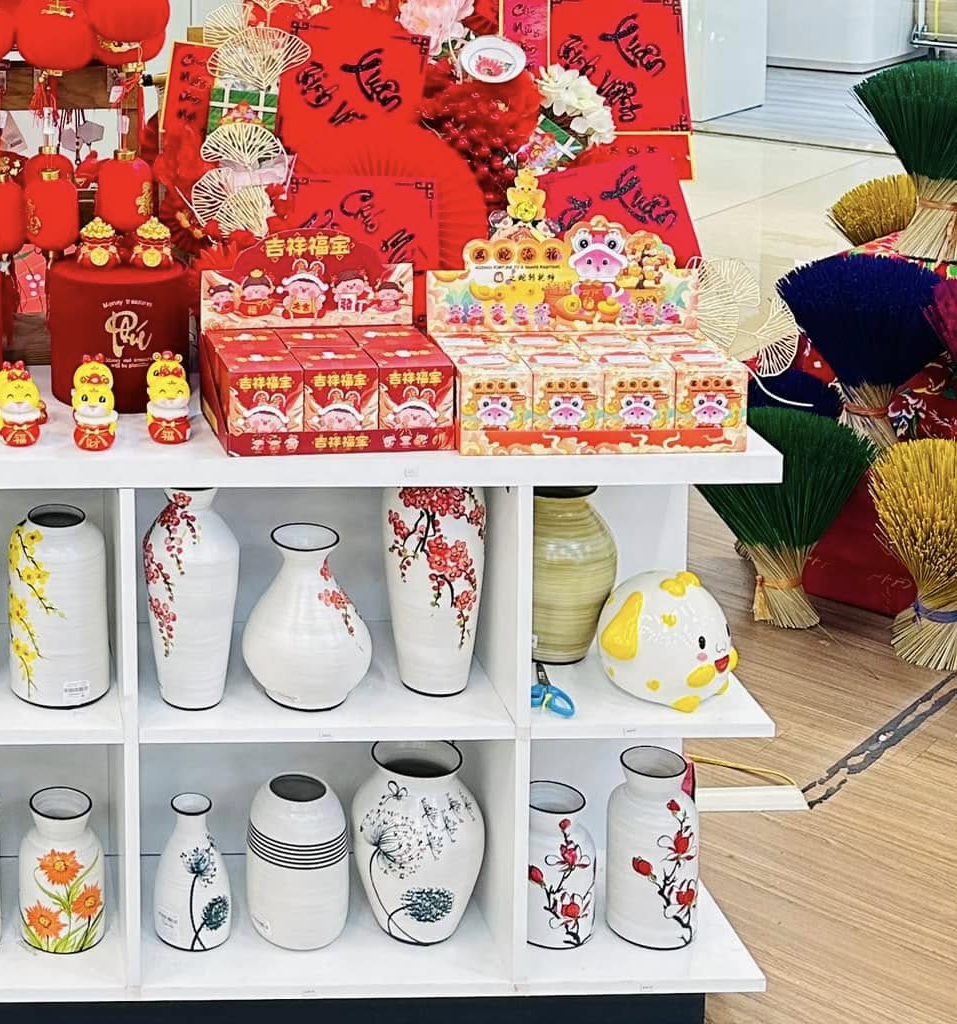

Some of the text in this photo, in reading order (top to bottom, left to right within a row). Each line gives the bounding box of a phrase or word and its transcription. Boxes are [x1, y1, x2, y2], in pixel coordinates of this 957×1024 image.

[264, 235, 352, 258] 吉祥福宝
[239, 376, 292, 390] 吉祥福宝
[313, 373, 367, 387] 吉祥福宝
[389, 371, 443, 385] 吉祥福宝
[314, 434, 369, 448] 吉祥福宝
